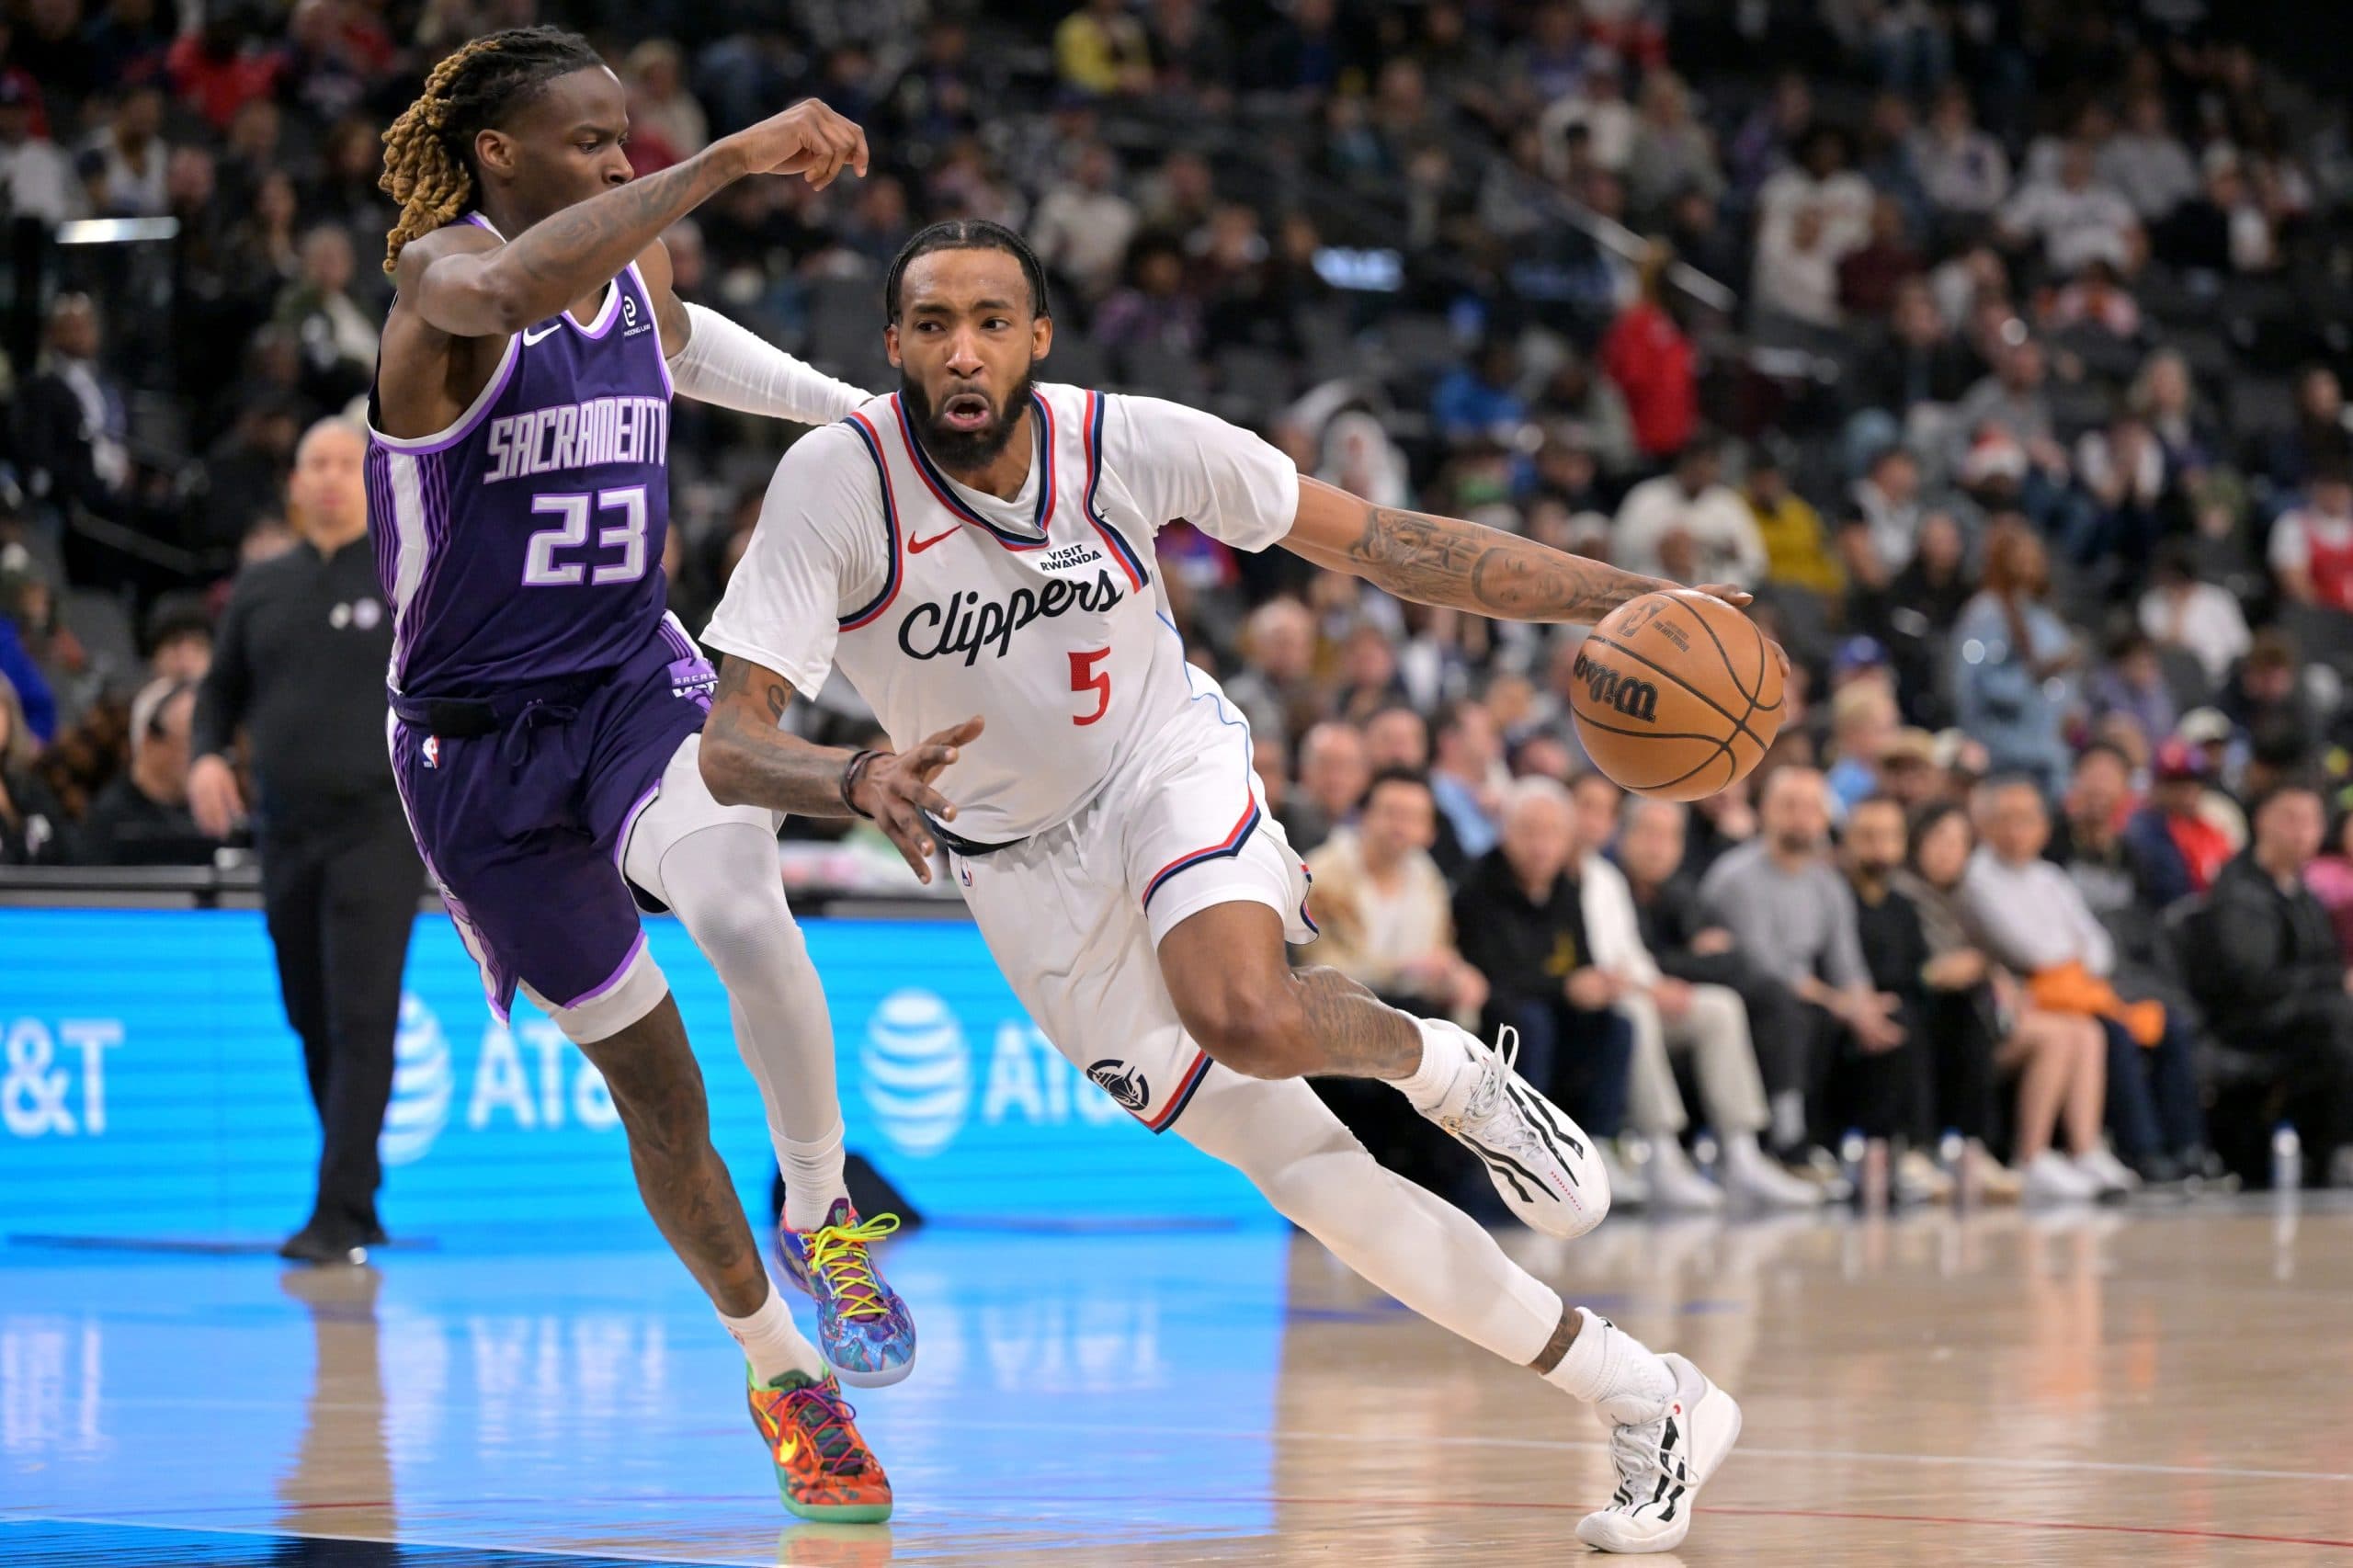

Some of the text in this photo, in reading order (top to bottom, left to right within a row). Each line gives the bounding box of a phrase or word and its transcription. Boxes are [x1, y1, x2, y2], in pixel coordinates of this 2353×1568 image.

[483, 396, 668, 485] SACRAMENTO
[521, 484, 647, 586] 23
[1040, 551, 1102, 571] RWANDA
[1048, 544, 1083, 560] VISIT
[898, 569, 1124, 667] Clippers
[1067, 646, 1110, 726] 5
[1574, 653, 1658, 722] Wilso
[0, 1017, 124, 1137] &T
